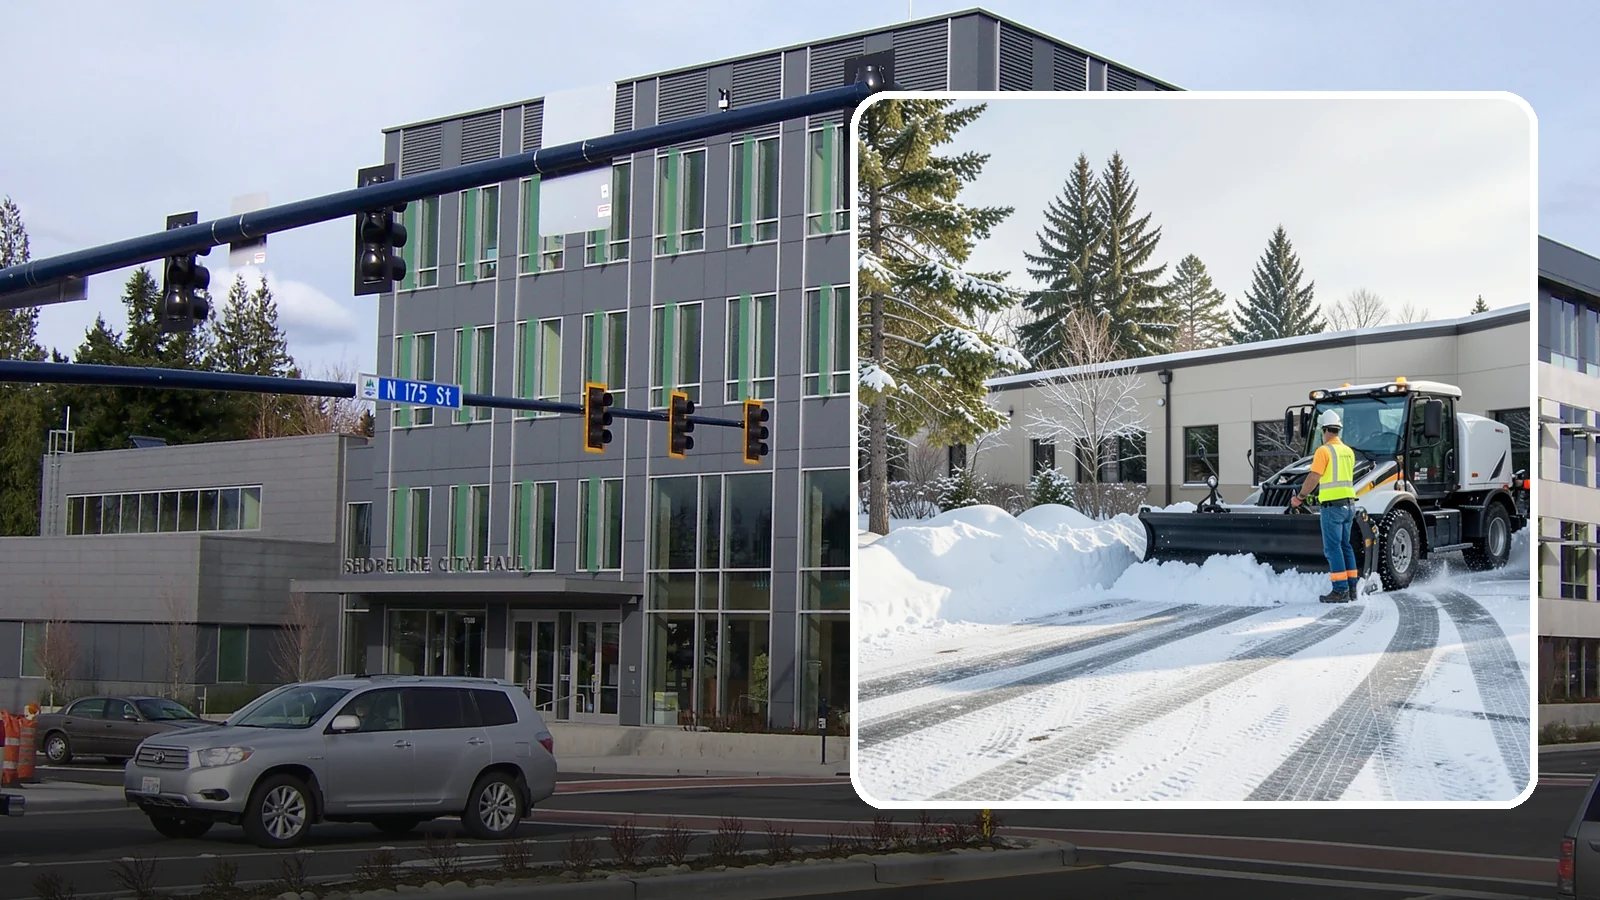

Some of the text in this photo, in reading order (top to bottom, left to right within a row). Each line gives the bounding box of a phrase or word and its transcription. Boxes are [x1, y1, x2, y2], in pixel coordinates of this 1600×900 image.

[387, 380, 452, 406] N 175 St
[345, 555, 524, 574] SHORELINE CITY HALL
